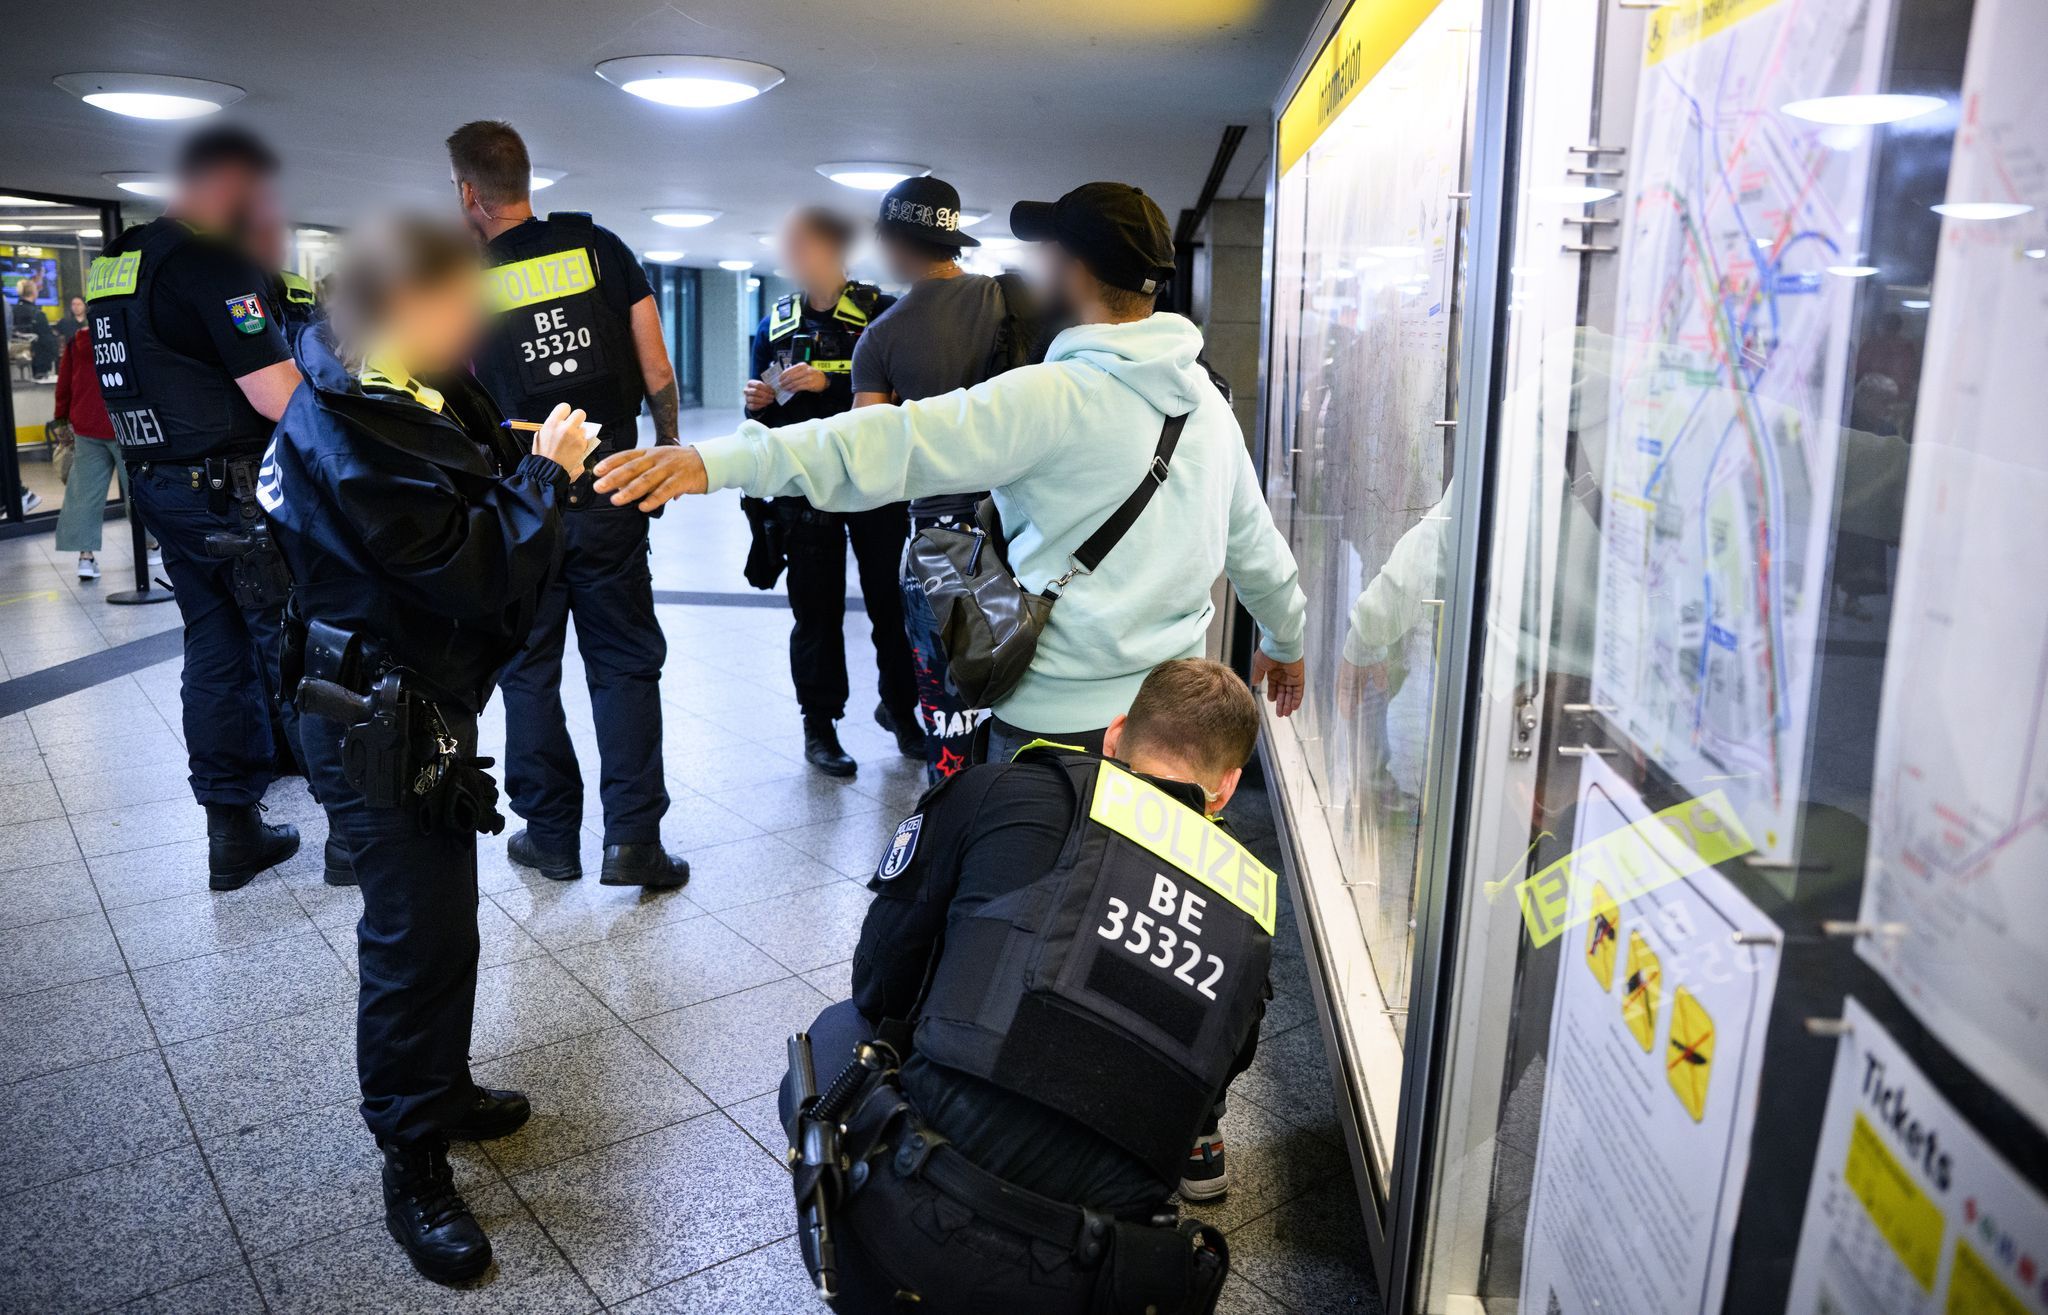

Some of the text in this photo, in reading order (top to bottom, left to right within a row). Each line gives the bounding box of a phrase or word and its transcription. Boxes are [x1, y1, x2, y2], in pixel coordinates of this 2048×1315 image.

[88, 257, 137, 292] OLIZEI
[96, 316, 113, 339] BE
[533, 307, 568, 334] BE
[521, 327, 591, 362] 35320
[111, 408, 164, 446] OLIZEI
[1101, 769, 1270, 922] POLIZEI
[1148, 872, 1207, 936] BE
[1097, 896, 1225, 1001] 35322
[1862, 1049, 1953, 1192] Tickets
